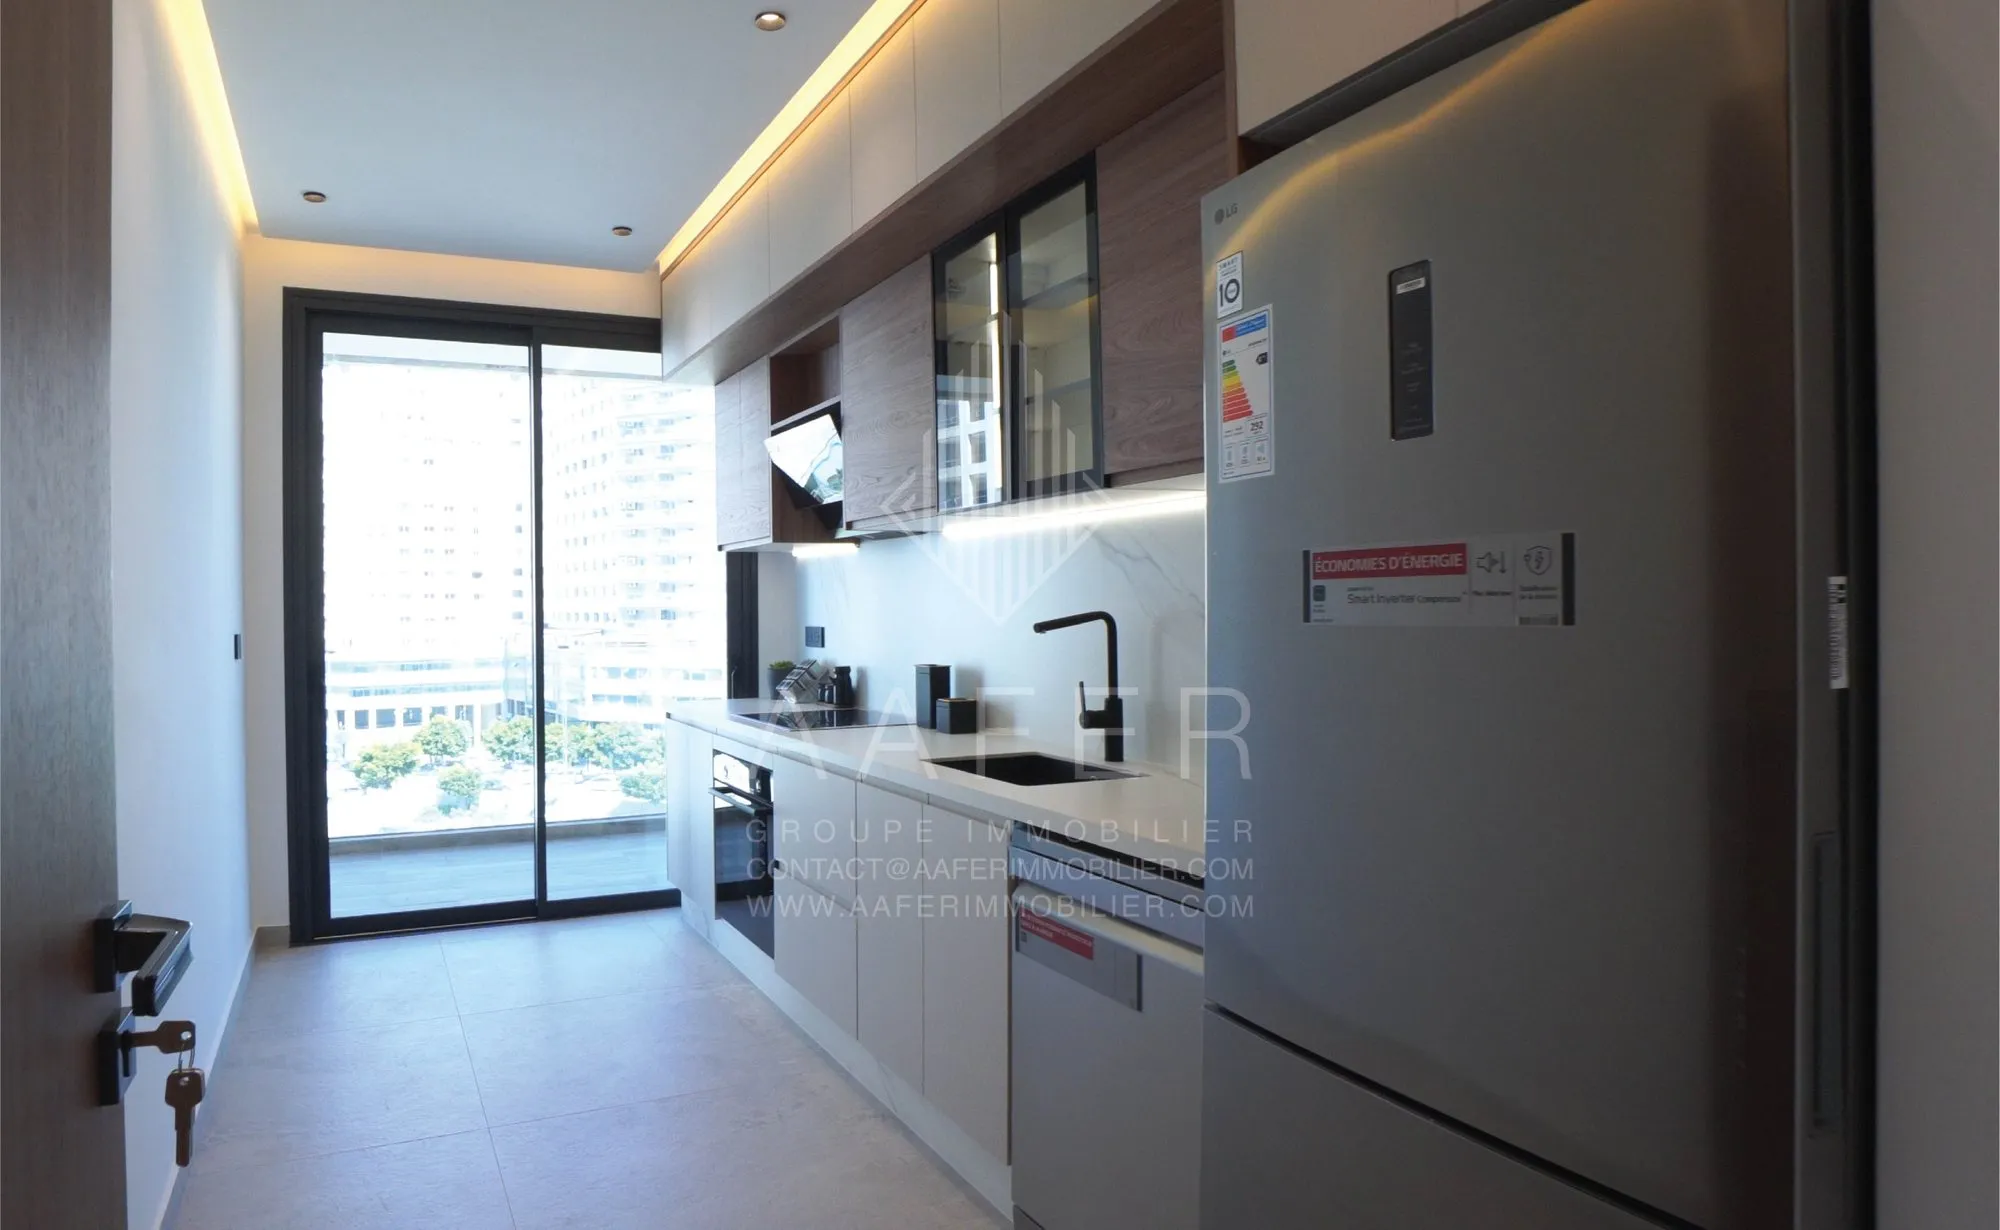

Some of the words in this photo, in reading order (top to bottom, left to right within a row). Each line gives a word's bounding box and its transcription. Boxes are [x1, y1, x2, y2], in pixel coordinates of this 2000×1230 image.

[1225, 202, 1239, 219] LG
[1219, 278, 1240, 307] 10
[1315, 556, 1386, 573] ÉCONOMIES
[1388, 552, 1464, 571] D'ÉNERGIE
[1347, 593, 1374, 604] Smart
[1376, 593, 1415, 605] Inverter
